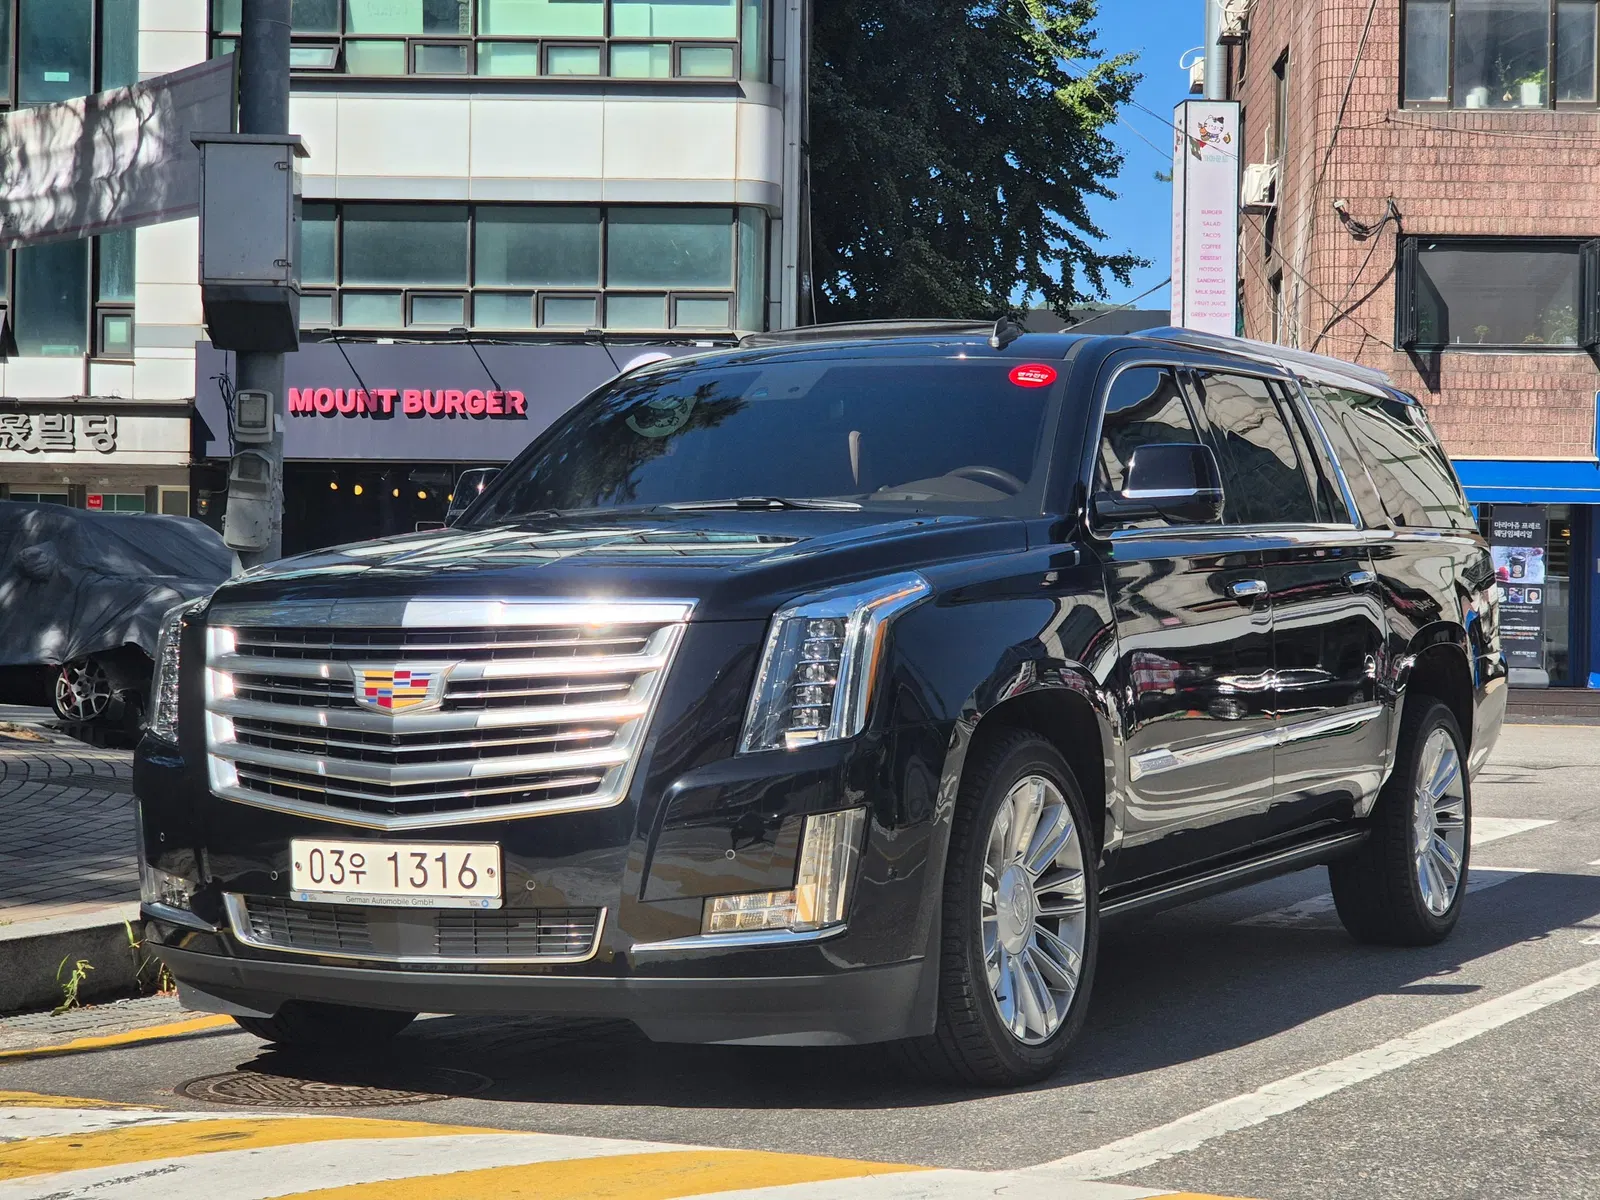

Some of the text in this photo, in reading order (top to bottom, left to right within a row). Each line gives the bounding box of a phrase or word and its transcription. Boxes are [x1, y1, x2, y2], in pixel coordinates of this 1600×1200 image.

[288, 387, 525, 415] MOUNT BURGER
[309, 848, 478, 890] 03우 1316
[345, 895, 434, 906] German Automobile GmbH
